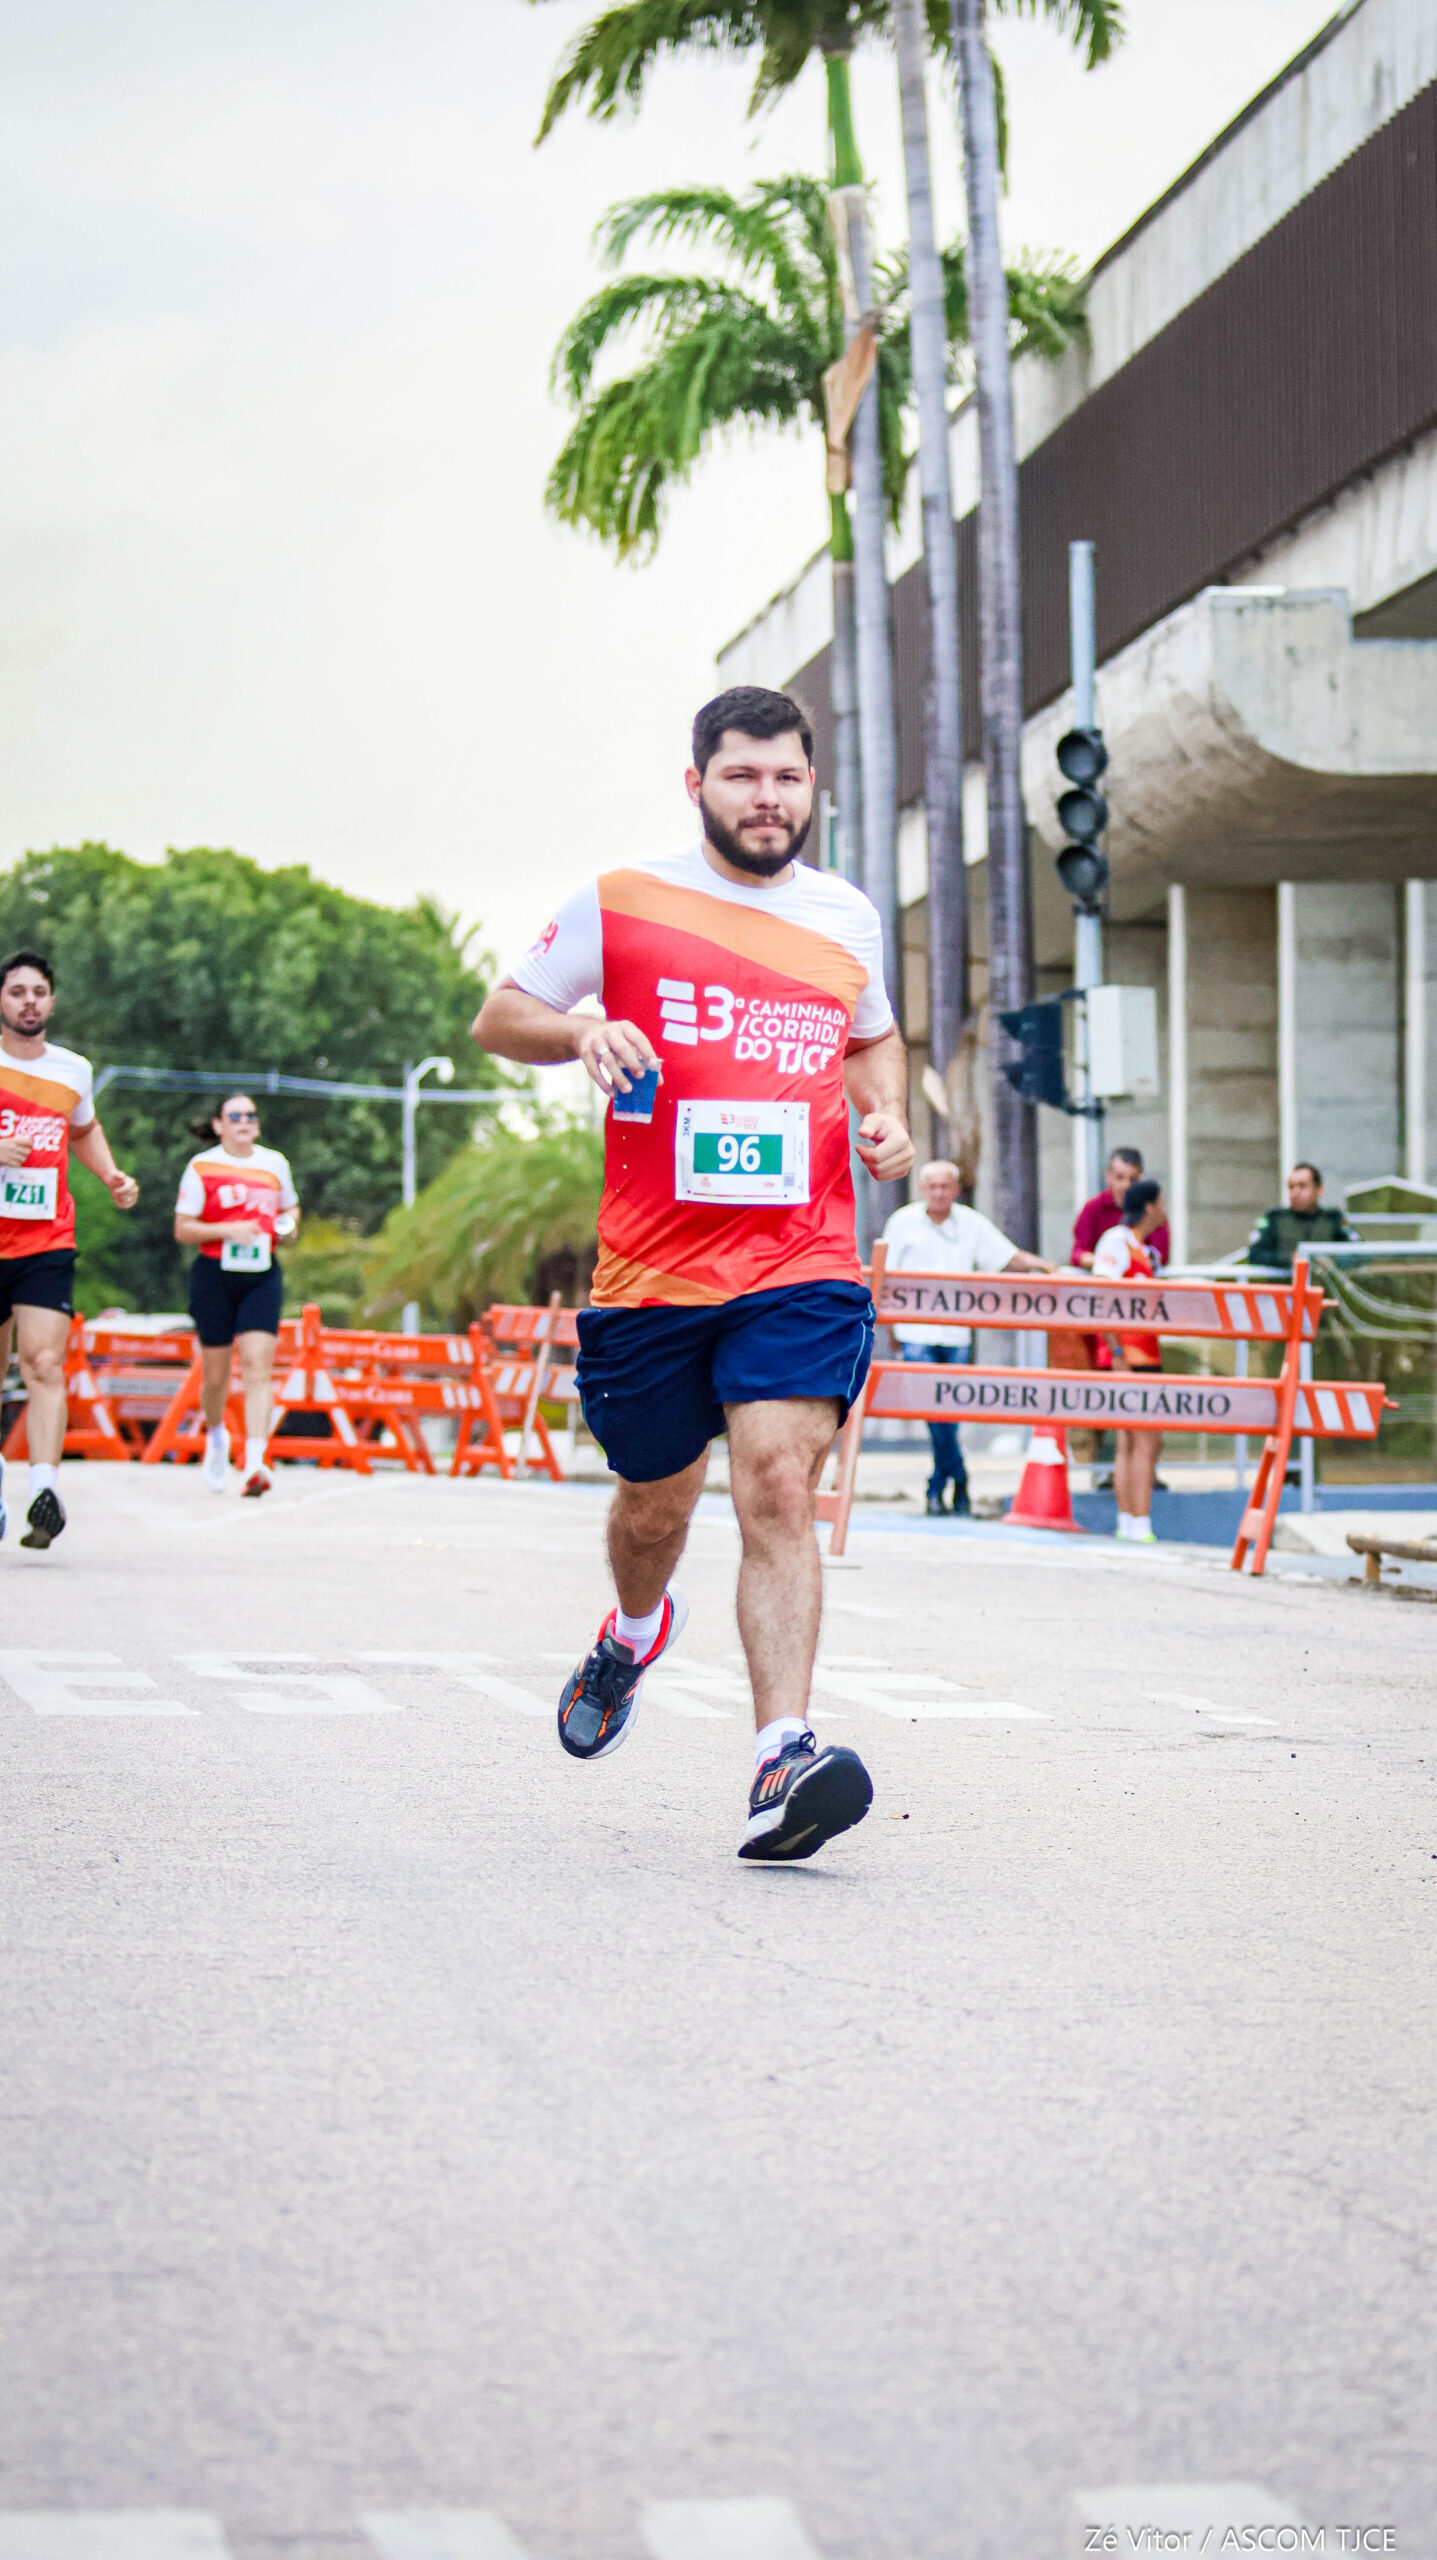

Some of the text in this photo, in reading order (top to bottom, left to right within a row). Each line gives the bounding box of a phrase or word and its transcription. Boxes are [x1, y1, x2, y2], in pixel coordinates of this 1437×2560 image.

[749, 1000, 847, 1028] CAMINHADA
[734, 1036, 772, 1060] DO
[717, 1135, 761, 1172] 96
[879, 1285, 1171, 1322] ESTADO DO CEARÁ
[934, 1381, 1231, 1417] PODER JUDICIÁRIO
